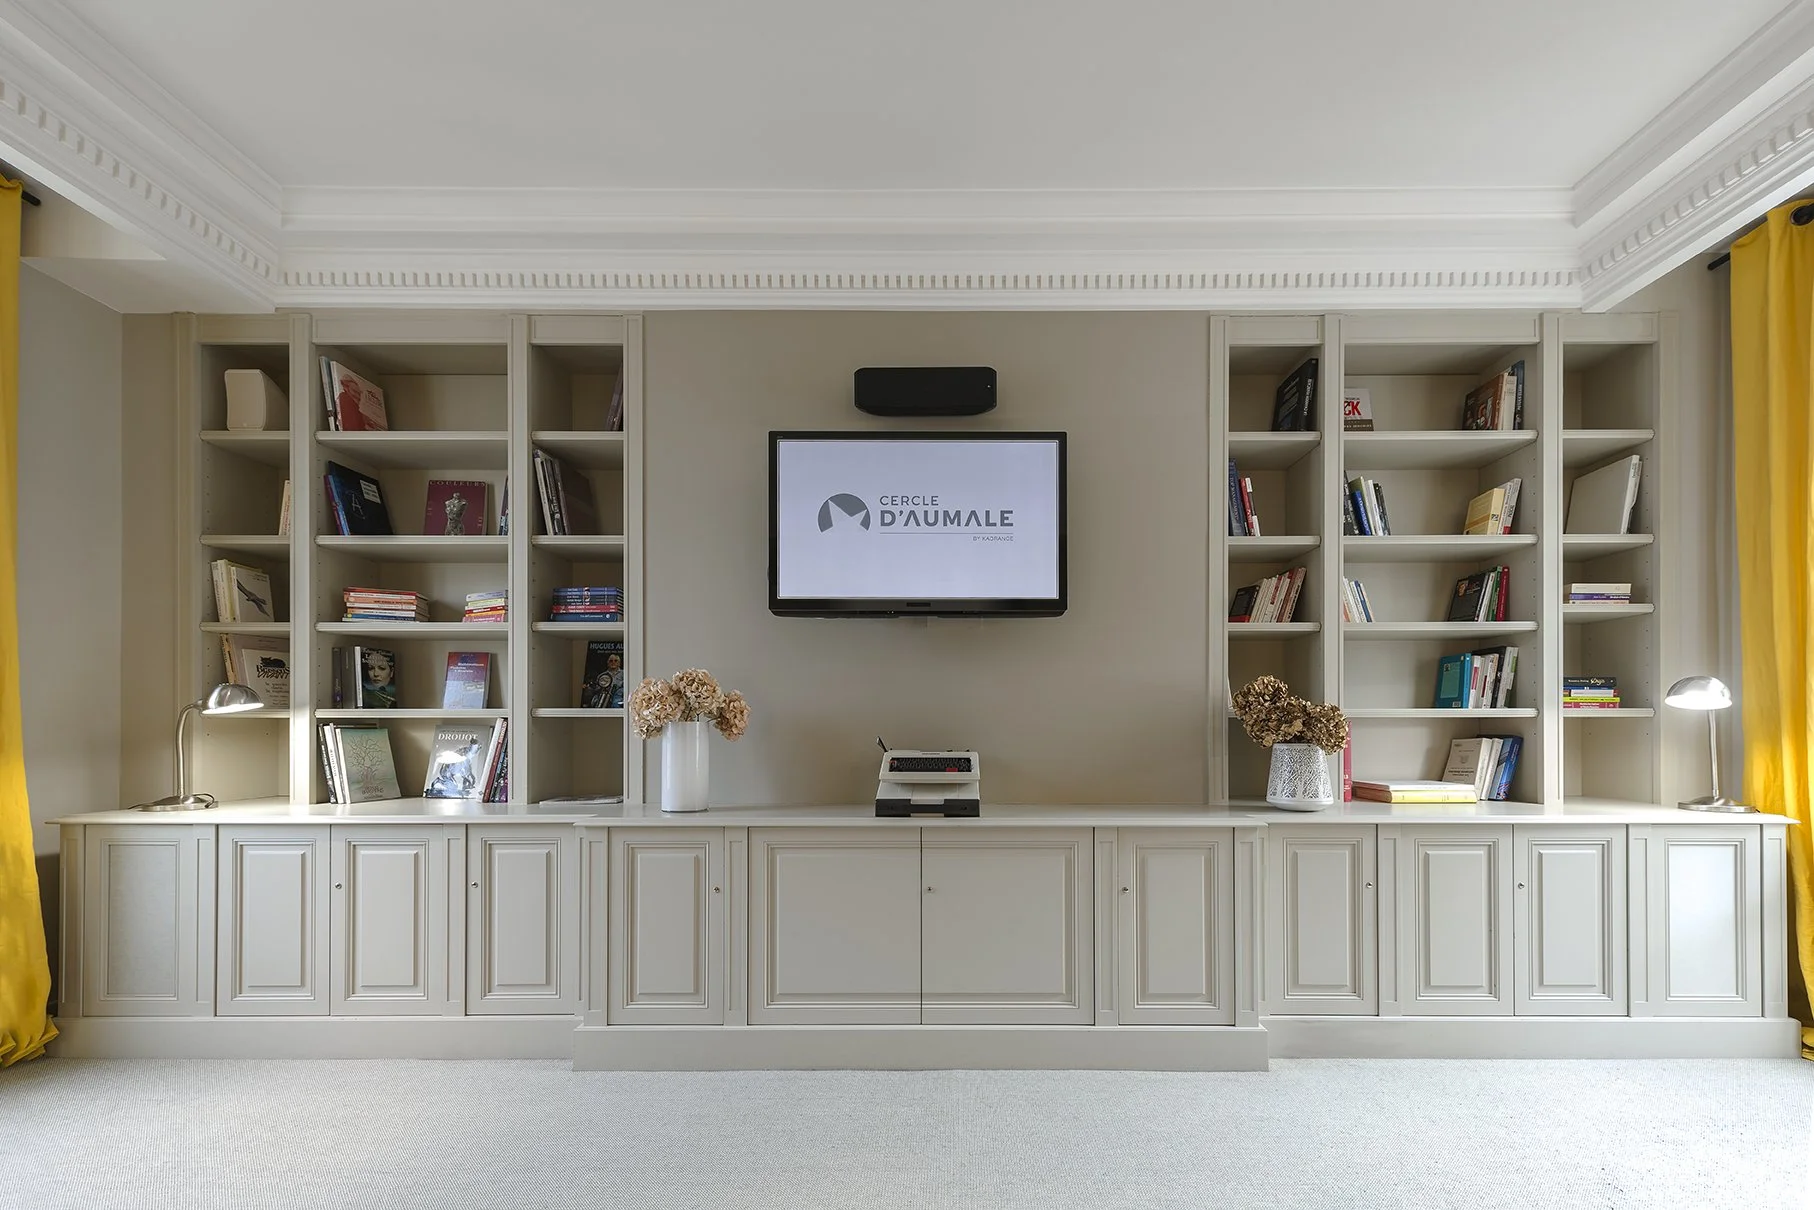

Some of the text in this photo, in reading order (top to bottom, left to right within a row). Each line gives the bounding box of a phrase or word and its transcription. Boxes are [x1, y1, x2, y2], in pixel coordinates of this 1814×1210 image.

[879, 495, 939, 506] CERCLE
[880, 509, 1014, 527] D'AUMALE
[438, 733, 479, 741] DROUOT
